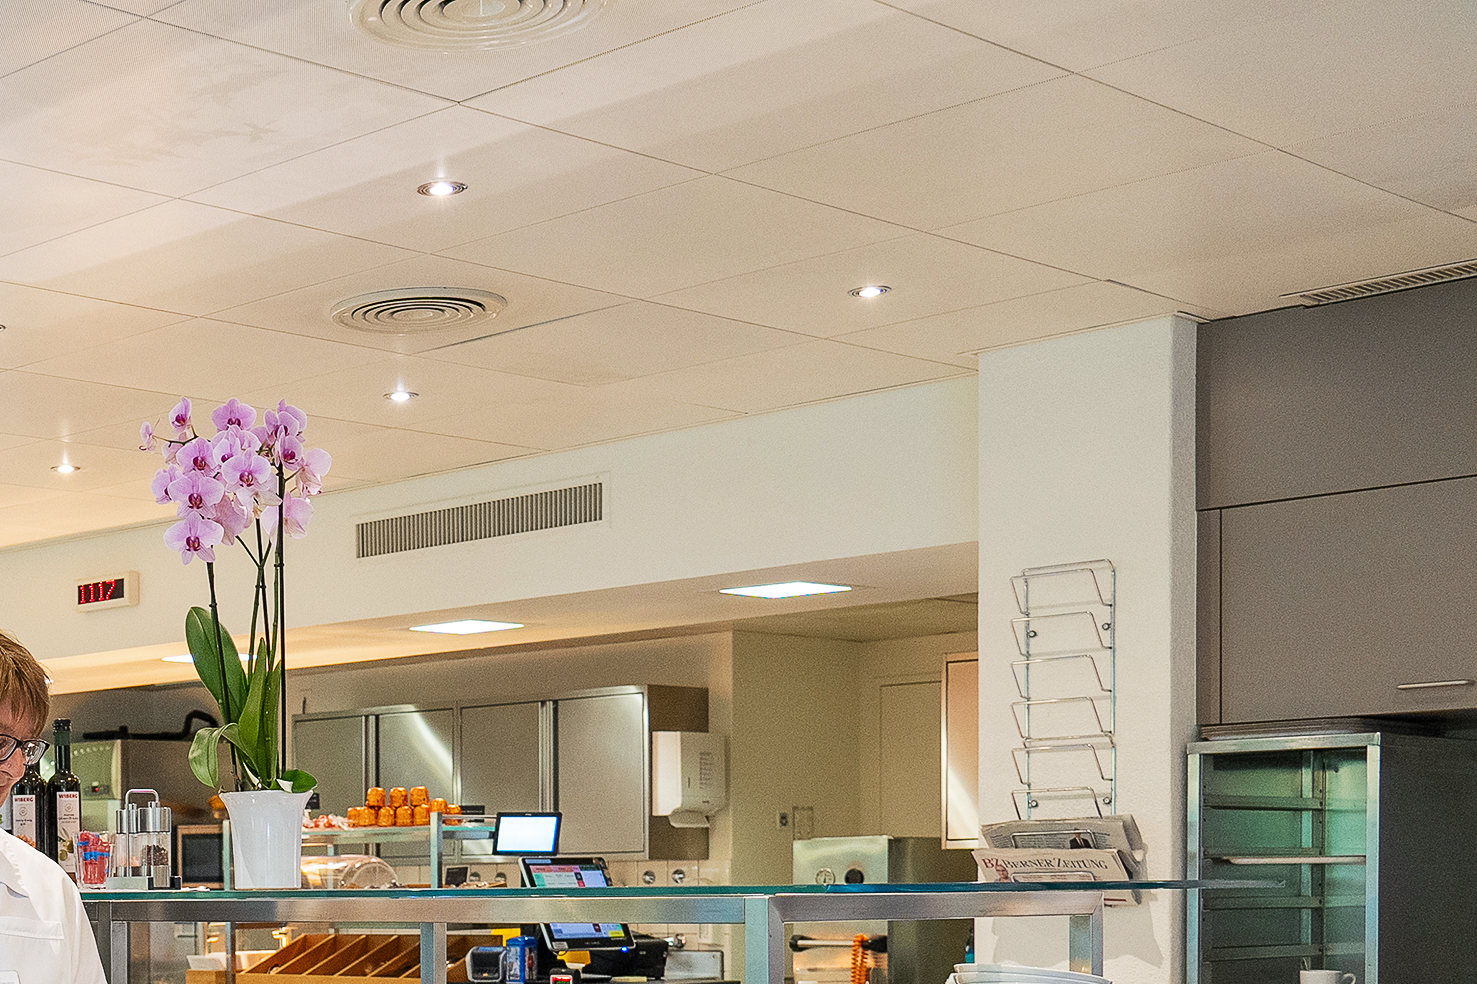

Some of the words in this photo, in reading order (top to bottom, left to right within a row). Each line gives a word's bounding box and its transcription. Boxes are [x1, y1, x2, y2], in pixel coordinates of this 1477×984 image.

[79, 579, 116, 604] 1117
[1002, 858, 1055, 869] BERNER
[1053, 857, 1109, 870] ZEITUNG
